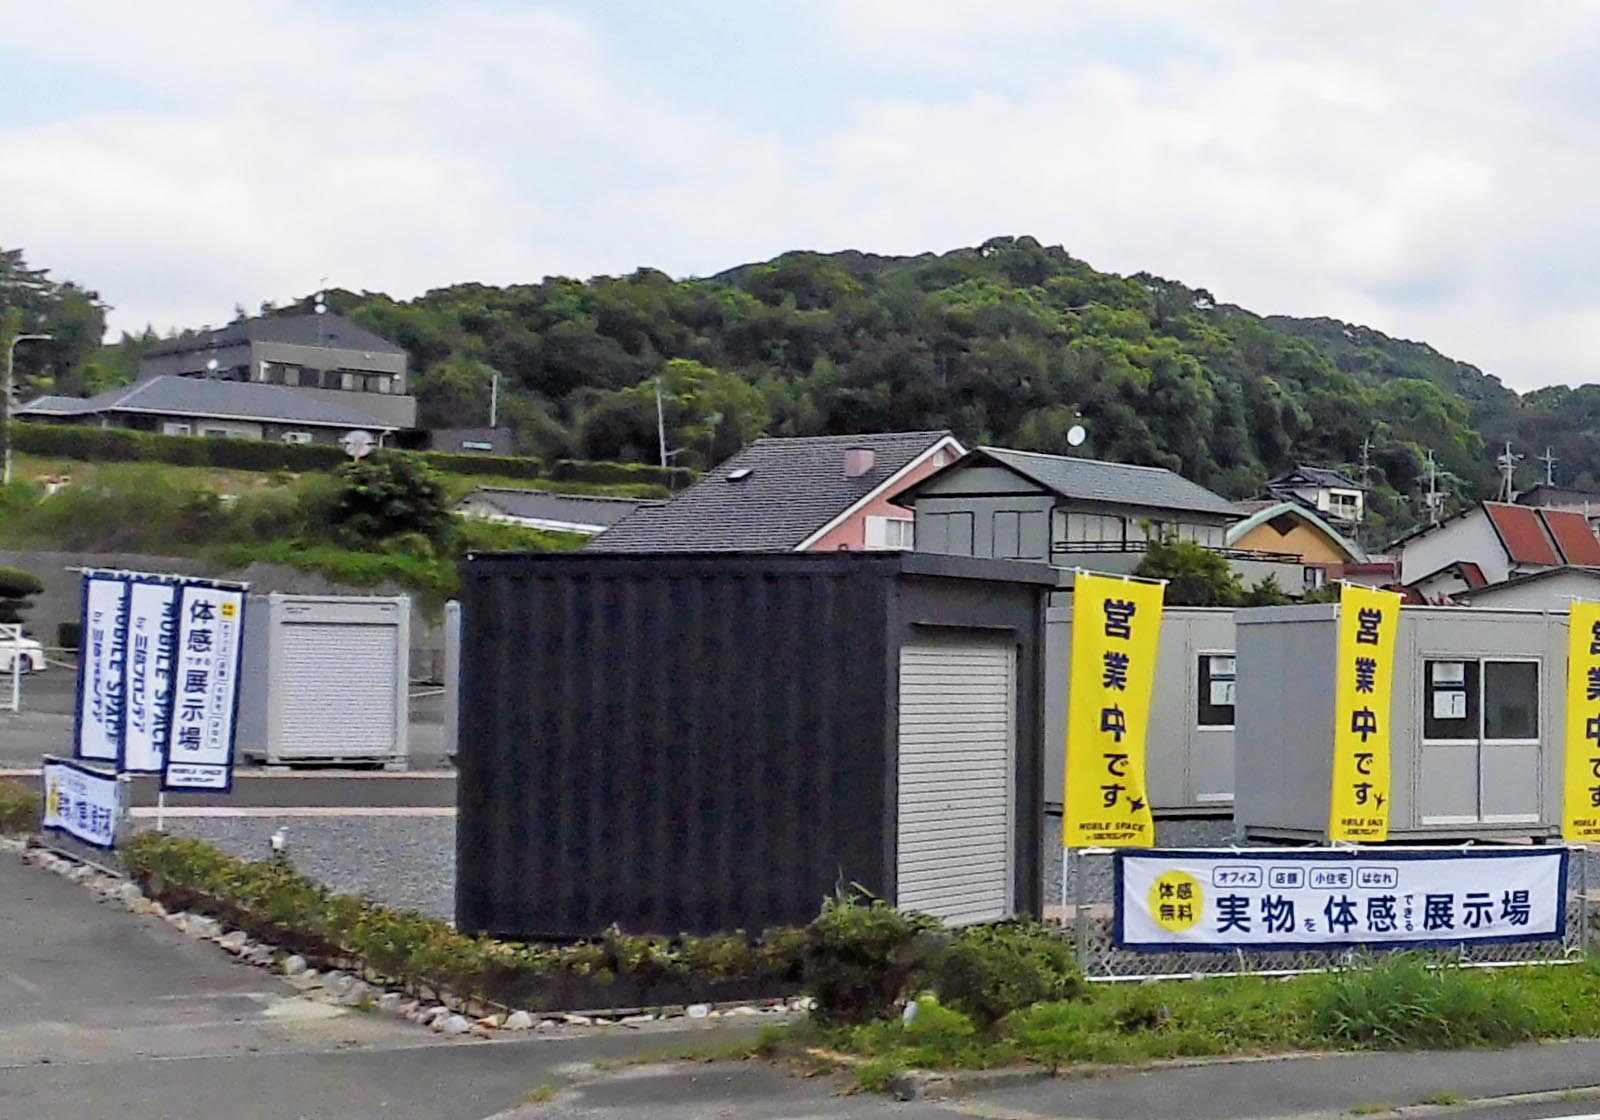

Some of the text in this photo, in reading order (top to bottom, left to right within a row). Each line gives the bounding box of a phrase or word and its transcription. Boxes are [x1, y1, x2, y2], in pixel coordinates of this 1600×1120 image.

[1100, 598, 1136, 809] 営業中です
[1351, 607, 1383, 806] 営業中です
[1219, 872, 1257, 883] オフィス
[1315, 873, 1348, 885] 小住宅
[1362, 873, 1392, 884] はなれ
[1159, 882, 1193, 900] 体感
[1160, 903, 1193, 921] 無料
